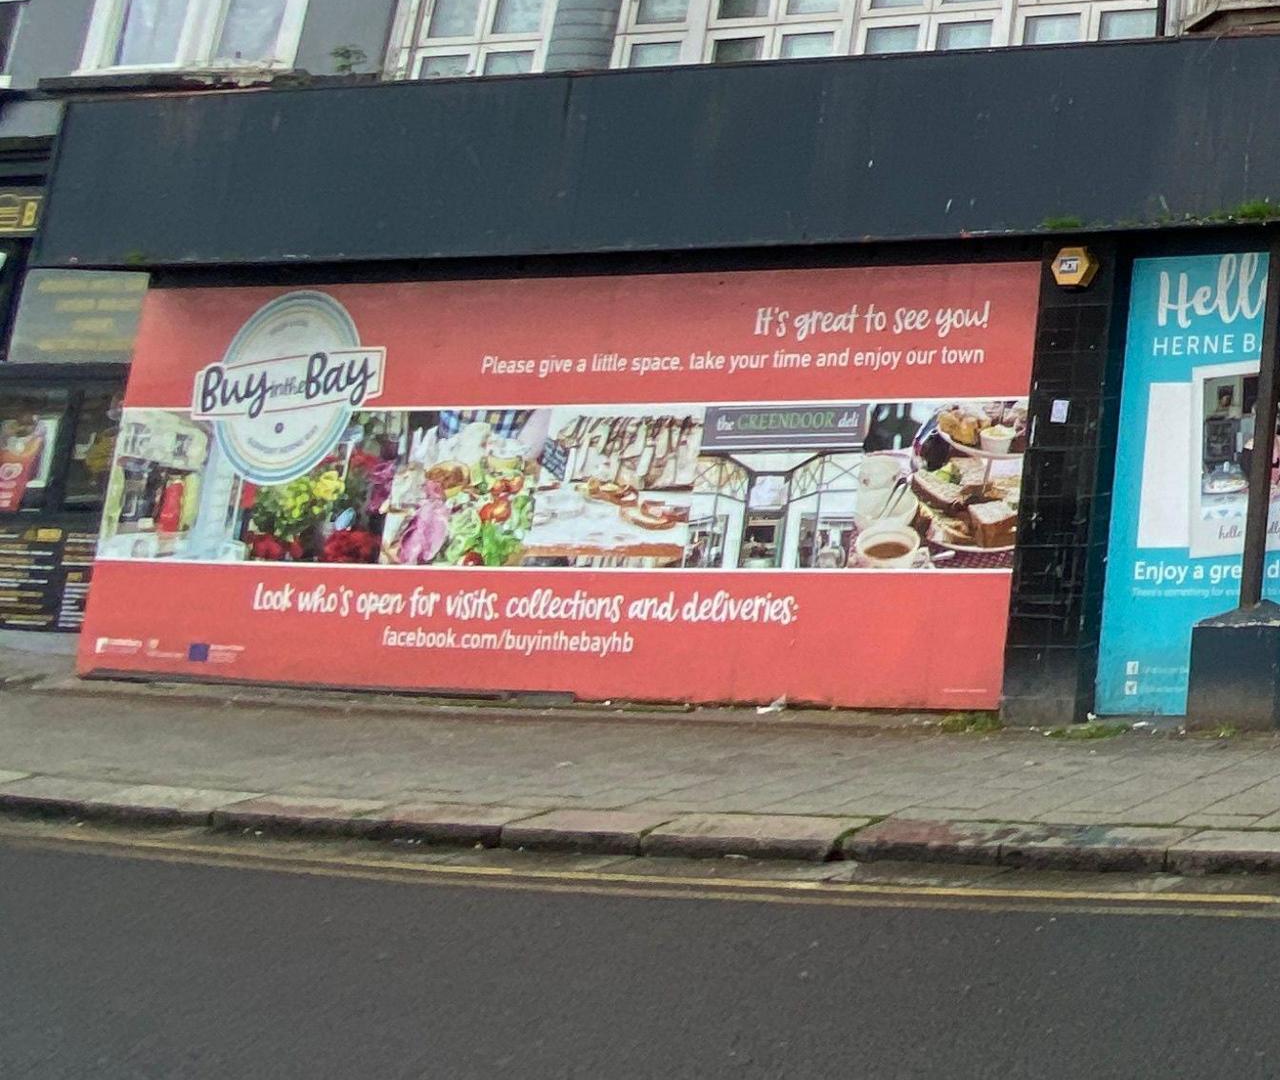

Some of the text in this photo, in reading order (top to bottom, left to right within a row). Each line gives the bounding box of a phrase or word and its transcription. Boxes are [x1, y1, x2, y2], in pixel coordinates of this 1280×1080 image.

[1158, 253, 1266, 329] Hell
[754, 300, 990, 341] It's great to see you!
[1153, 333, 1235, 356] HERNE
[481, 353, 535, 374] Please
[538, 355, 572, 378] give
[576, 356, 587, 372] a
[591, 352, 627, 372] little
[689, 351, 725, 370] take
[730, 353, 769, 374] your
[772, 349, 811, 368] time
[816, 348, 849, 367] and
[854, 346, 902, 371] enjoy
[906, 348, 936, 366] our
[941, 347, 985, 365] town
[202, 365, 272, 419] Buy
[305, 351, 376, 406] Bay
[716, 414, 735, 431] the
[1218, 524, 1241, 540] hello
[1134, 561, 1242, 584] Enjoy a gre
[253, 582, 295, 612] Look
[297, 583, 353, 618] who's
[356, 590, 407, 620] open
[410, 586, 441, 618] for
[505, 587, 624, 624] collections
[628, 591, 681, 623] and
[682, 589, 799, 625] deliveries:
[382, 625, 635, 658] facebook.com/buyinthebayhb
